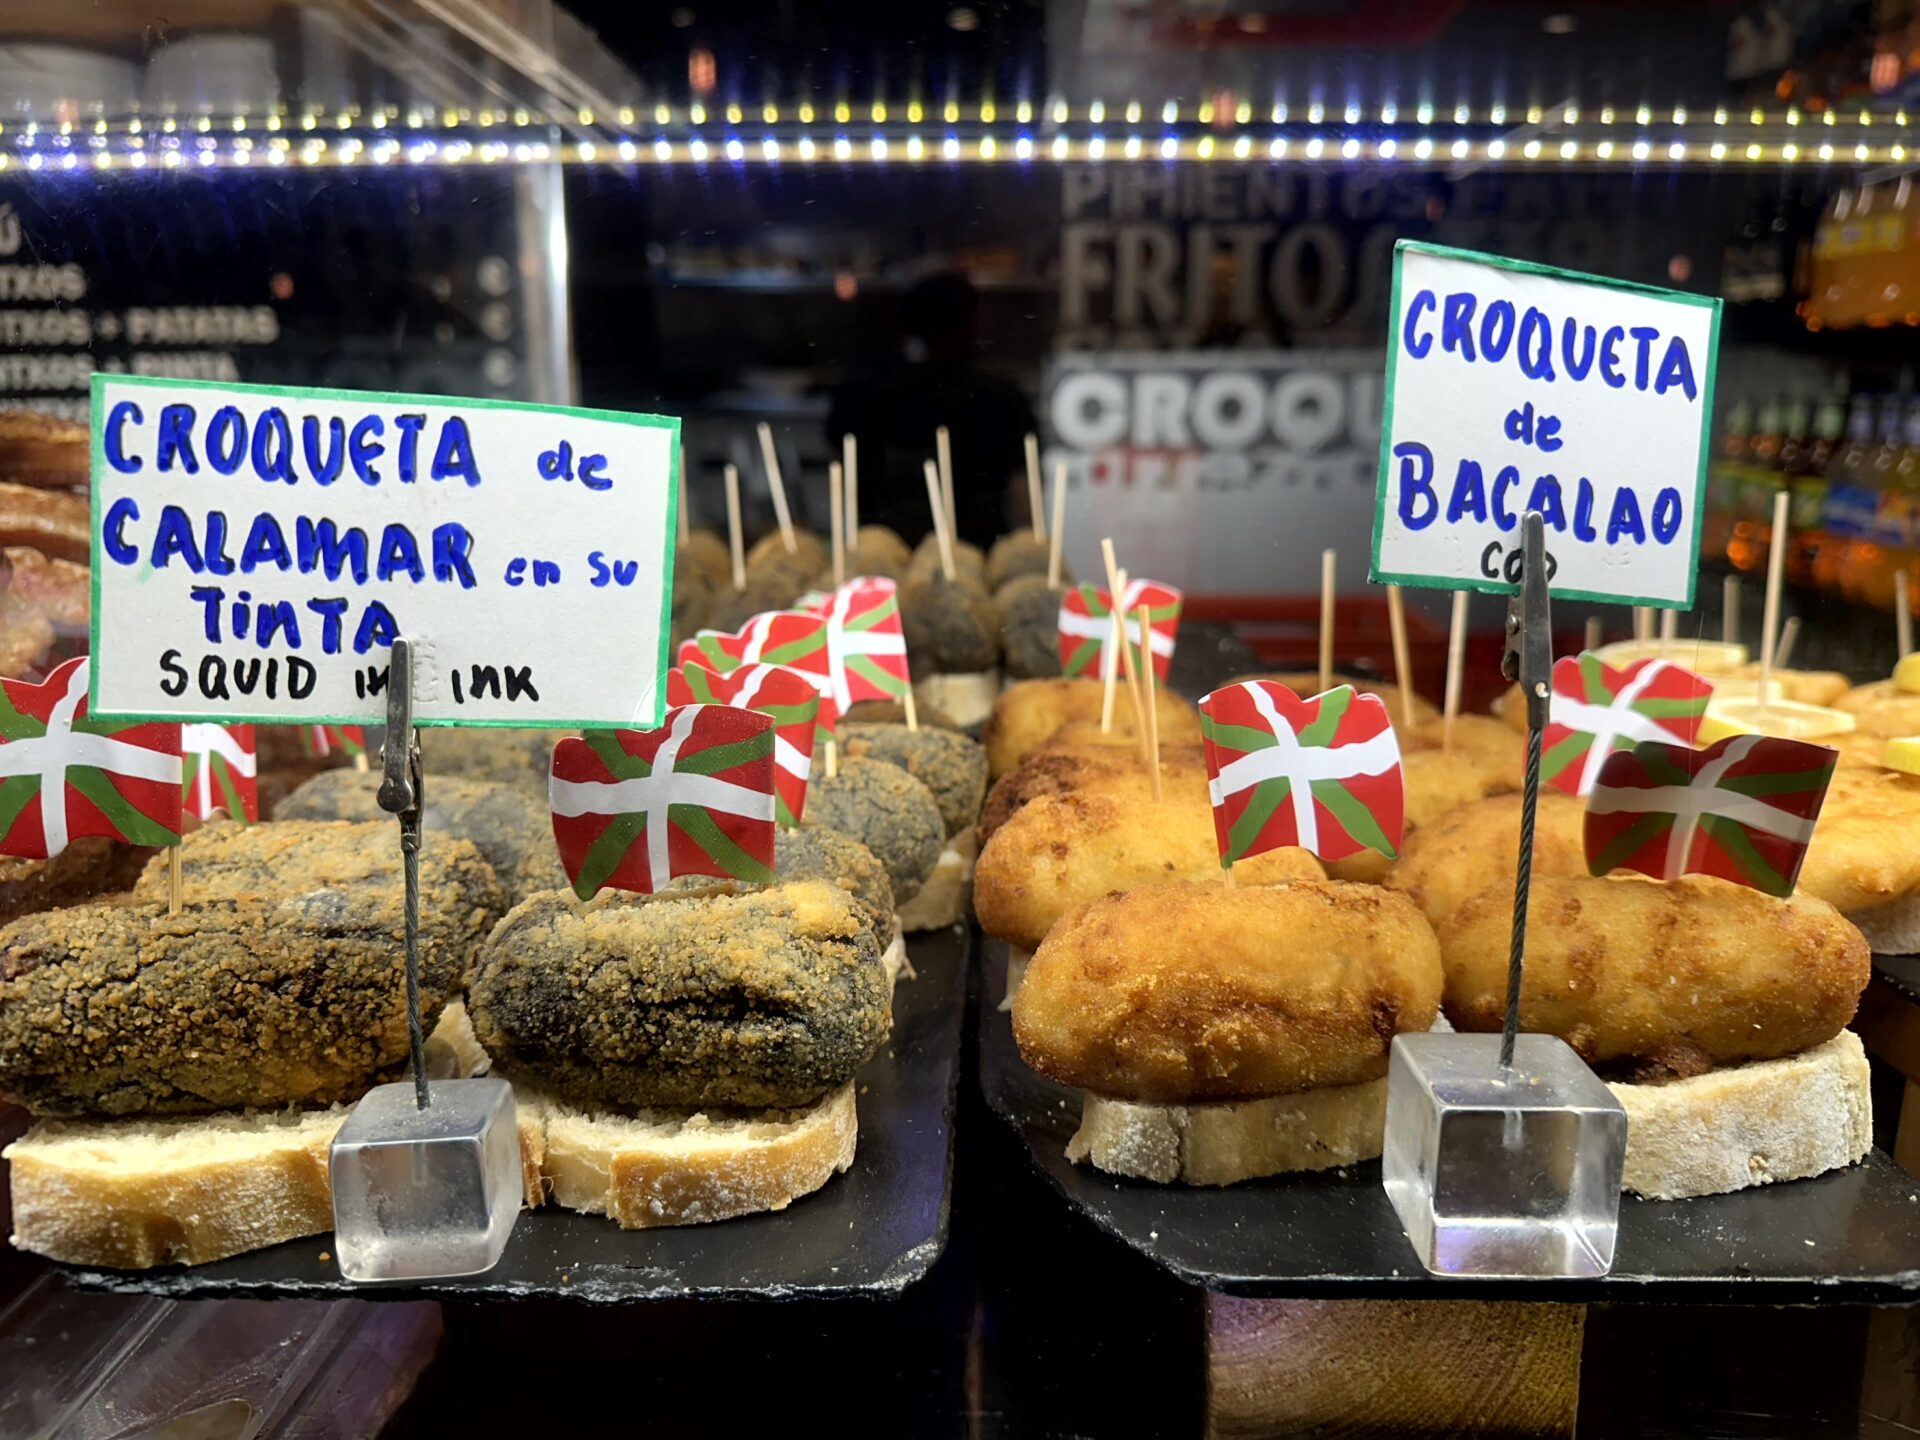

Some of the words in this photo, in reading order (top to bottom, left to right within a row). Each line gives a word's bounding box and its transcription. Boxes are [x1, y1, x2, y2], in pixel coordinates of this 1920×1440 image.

[1403, 289, 1697, 401] CROQUETA
[104, 401, 481, 488] CROQUETA
[537, 440, 613, 490] de
[1504, 402, 1563, 452] de
[1393, 441, 1682, 545] BACALAO
[103, 498, 476, 588] CALAMAR
[504, 557, 560, 587] en
[159, 649, 317, 700] SQUID
